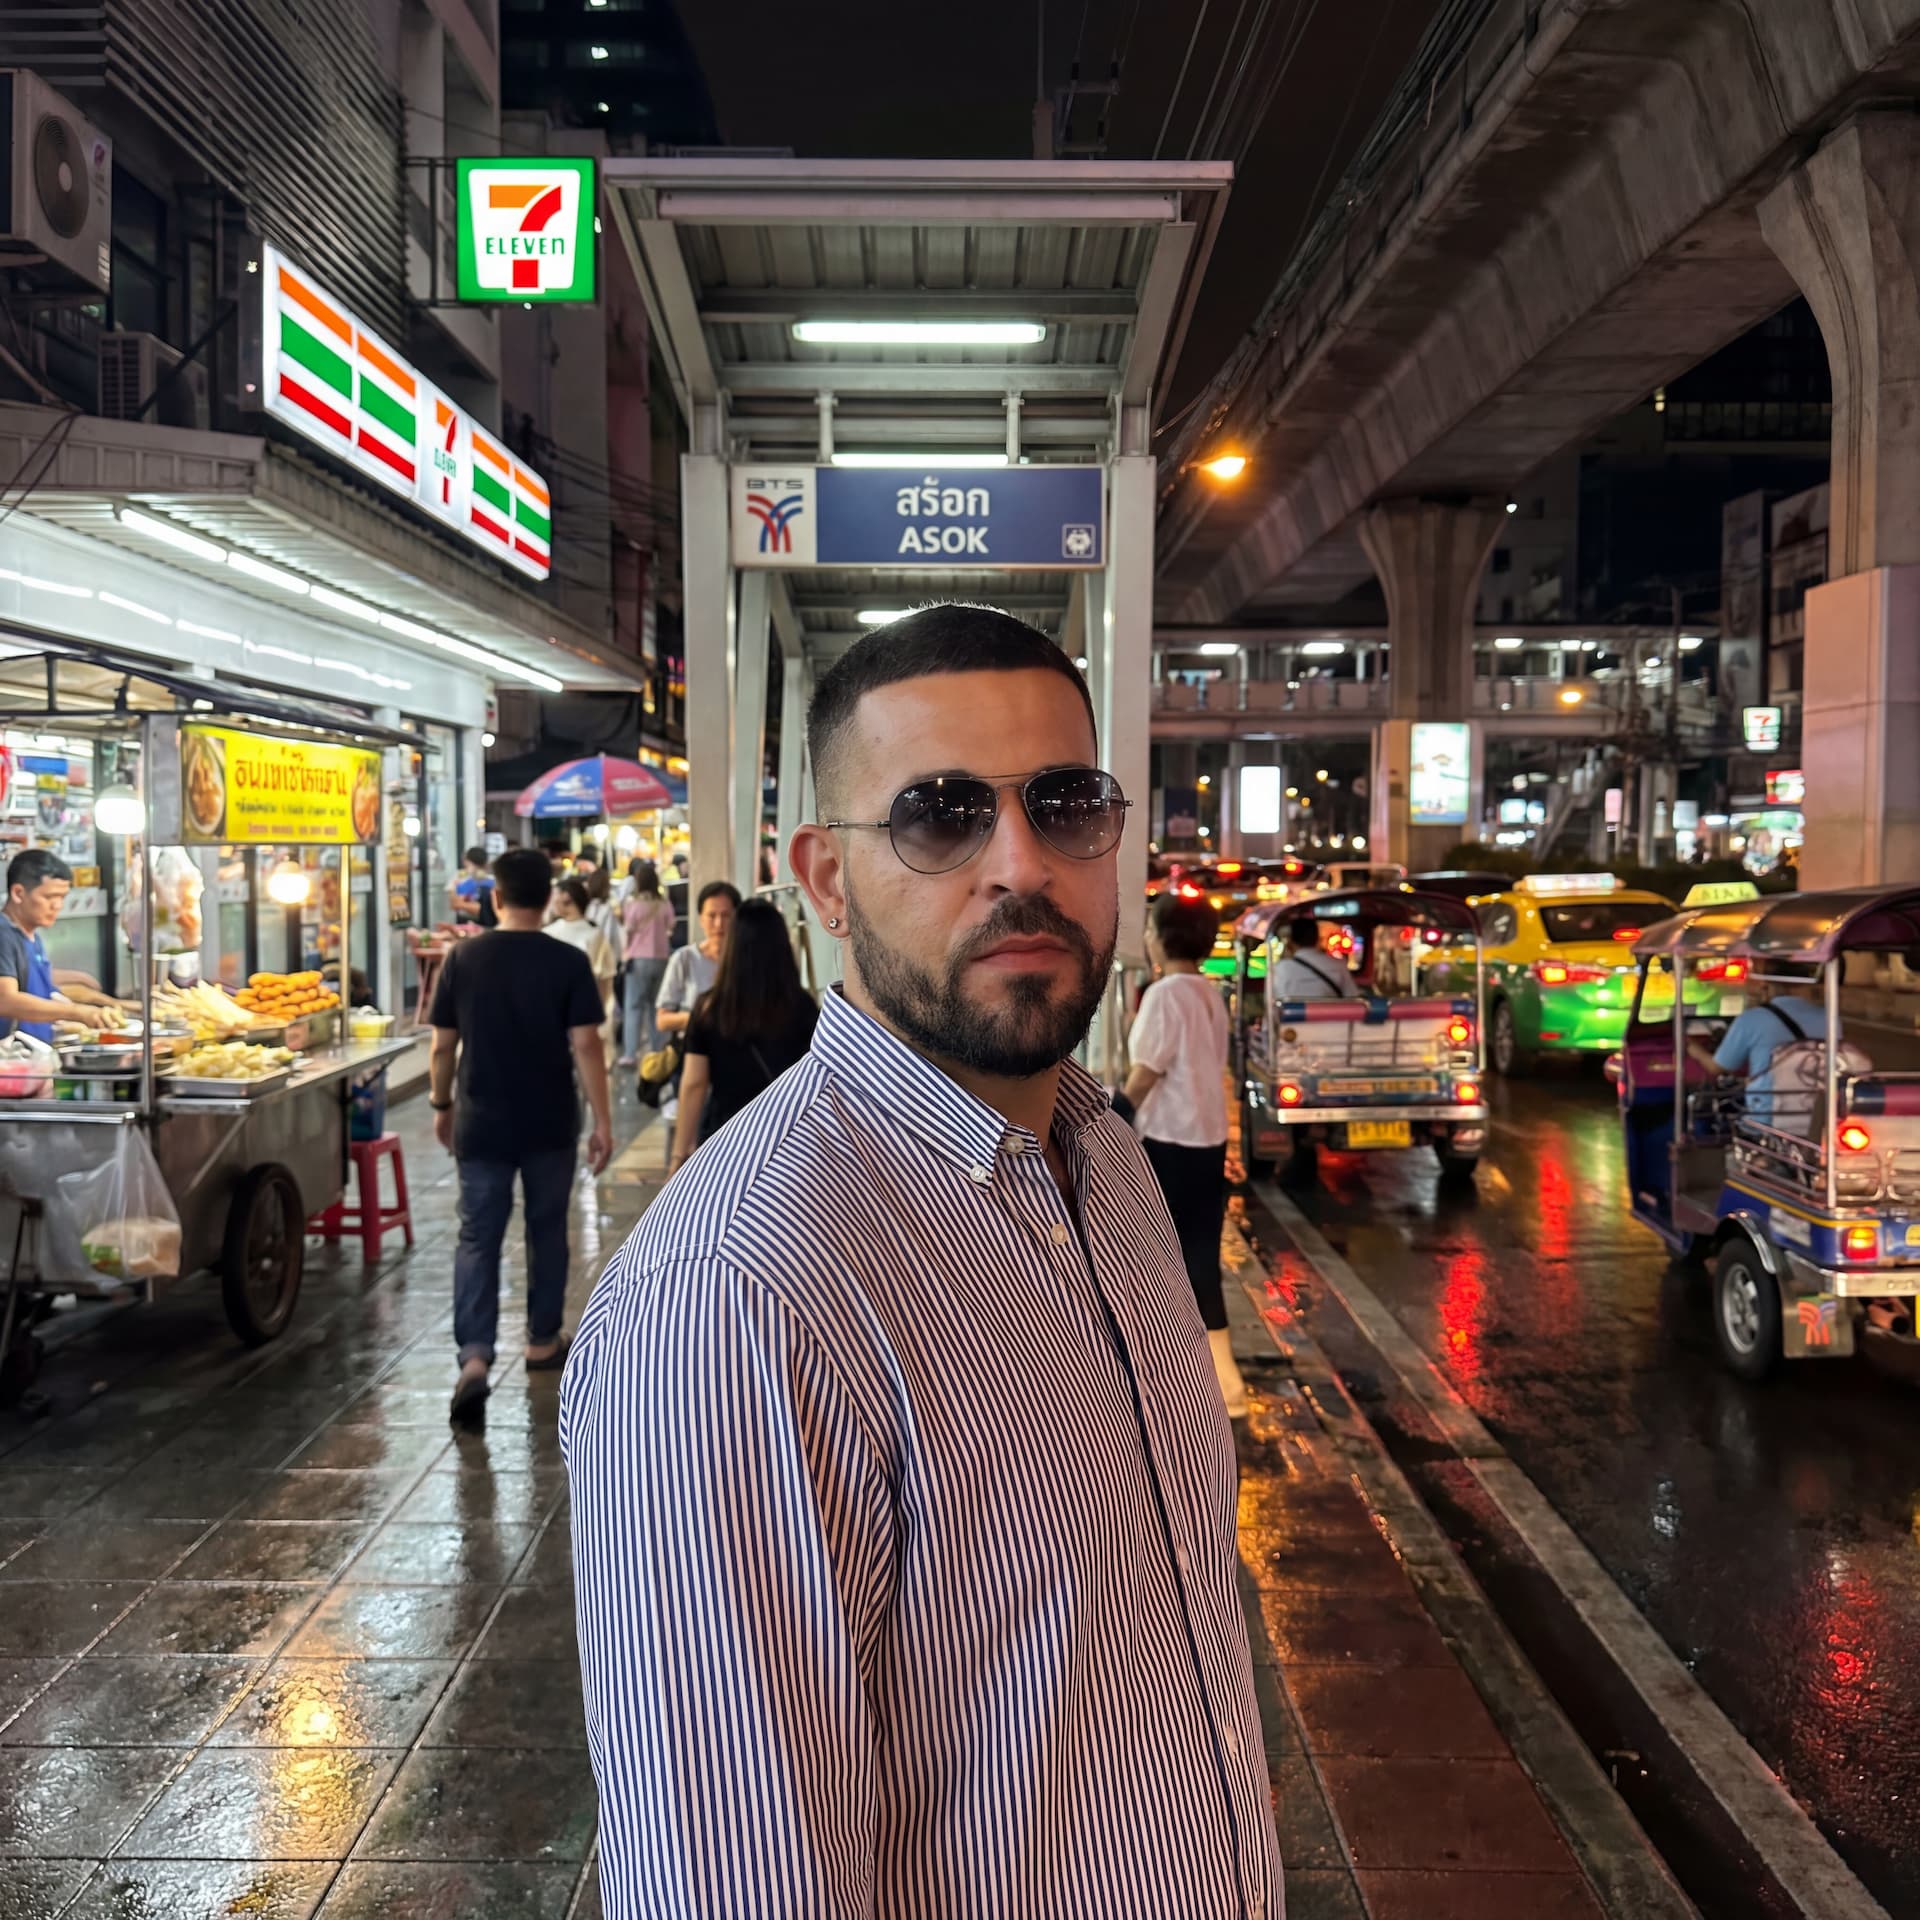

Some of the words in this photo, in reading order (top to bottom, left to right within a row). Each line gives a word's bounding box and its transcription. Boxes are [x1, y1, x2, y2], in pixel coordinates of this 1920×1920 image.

[489, 185, 562, 288] 7
[746, 478, 804, 490] BTS
[898, 526, 989, 554] ASOK
